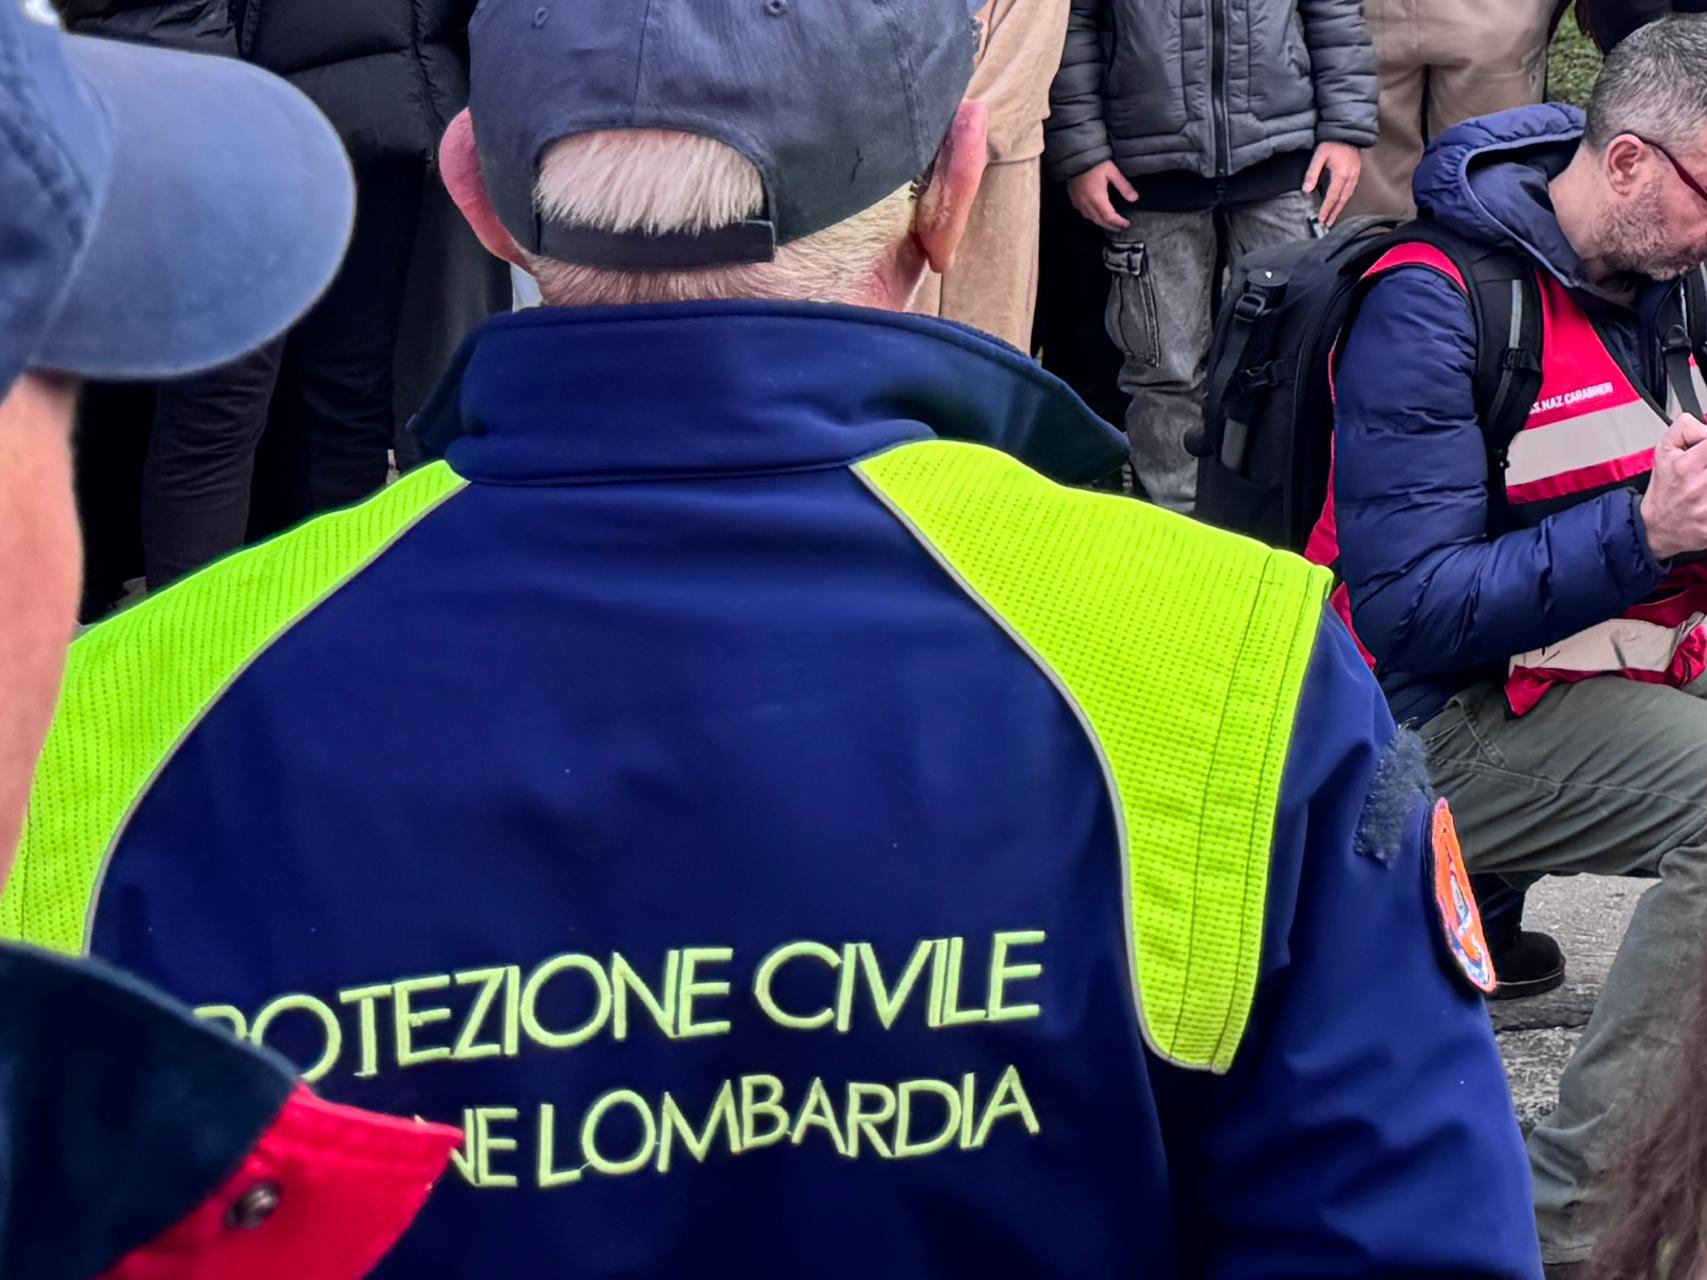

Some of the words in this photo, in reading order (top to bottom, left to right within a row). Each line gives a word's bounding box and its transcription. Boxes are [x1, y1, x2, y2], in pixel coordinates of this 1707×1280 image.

[194, 947, 734, 1080] OTEZIONE
[753, 930, 1045, 1032] CIVILE
[539, 1065, 1040, 1188] LOMBARDIA
